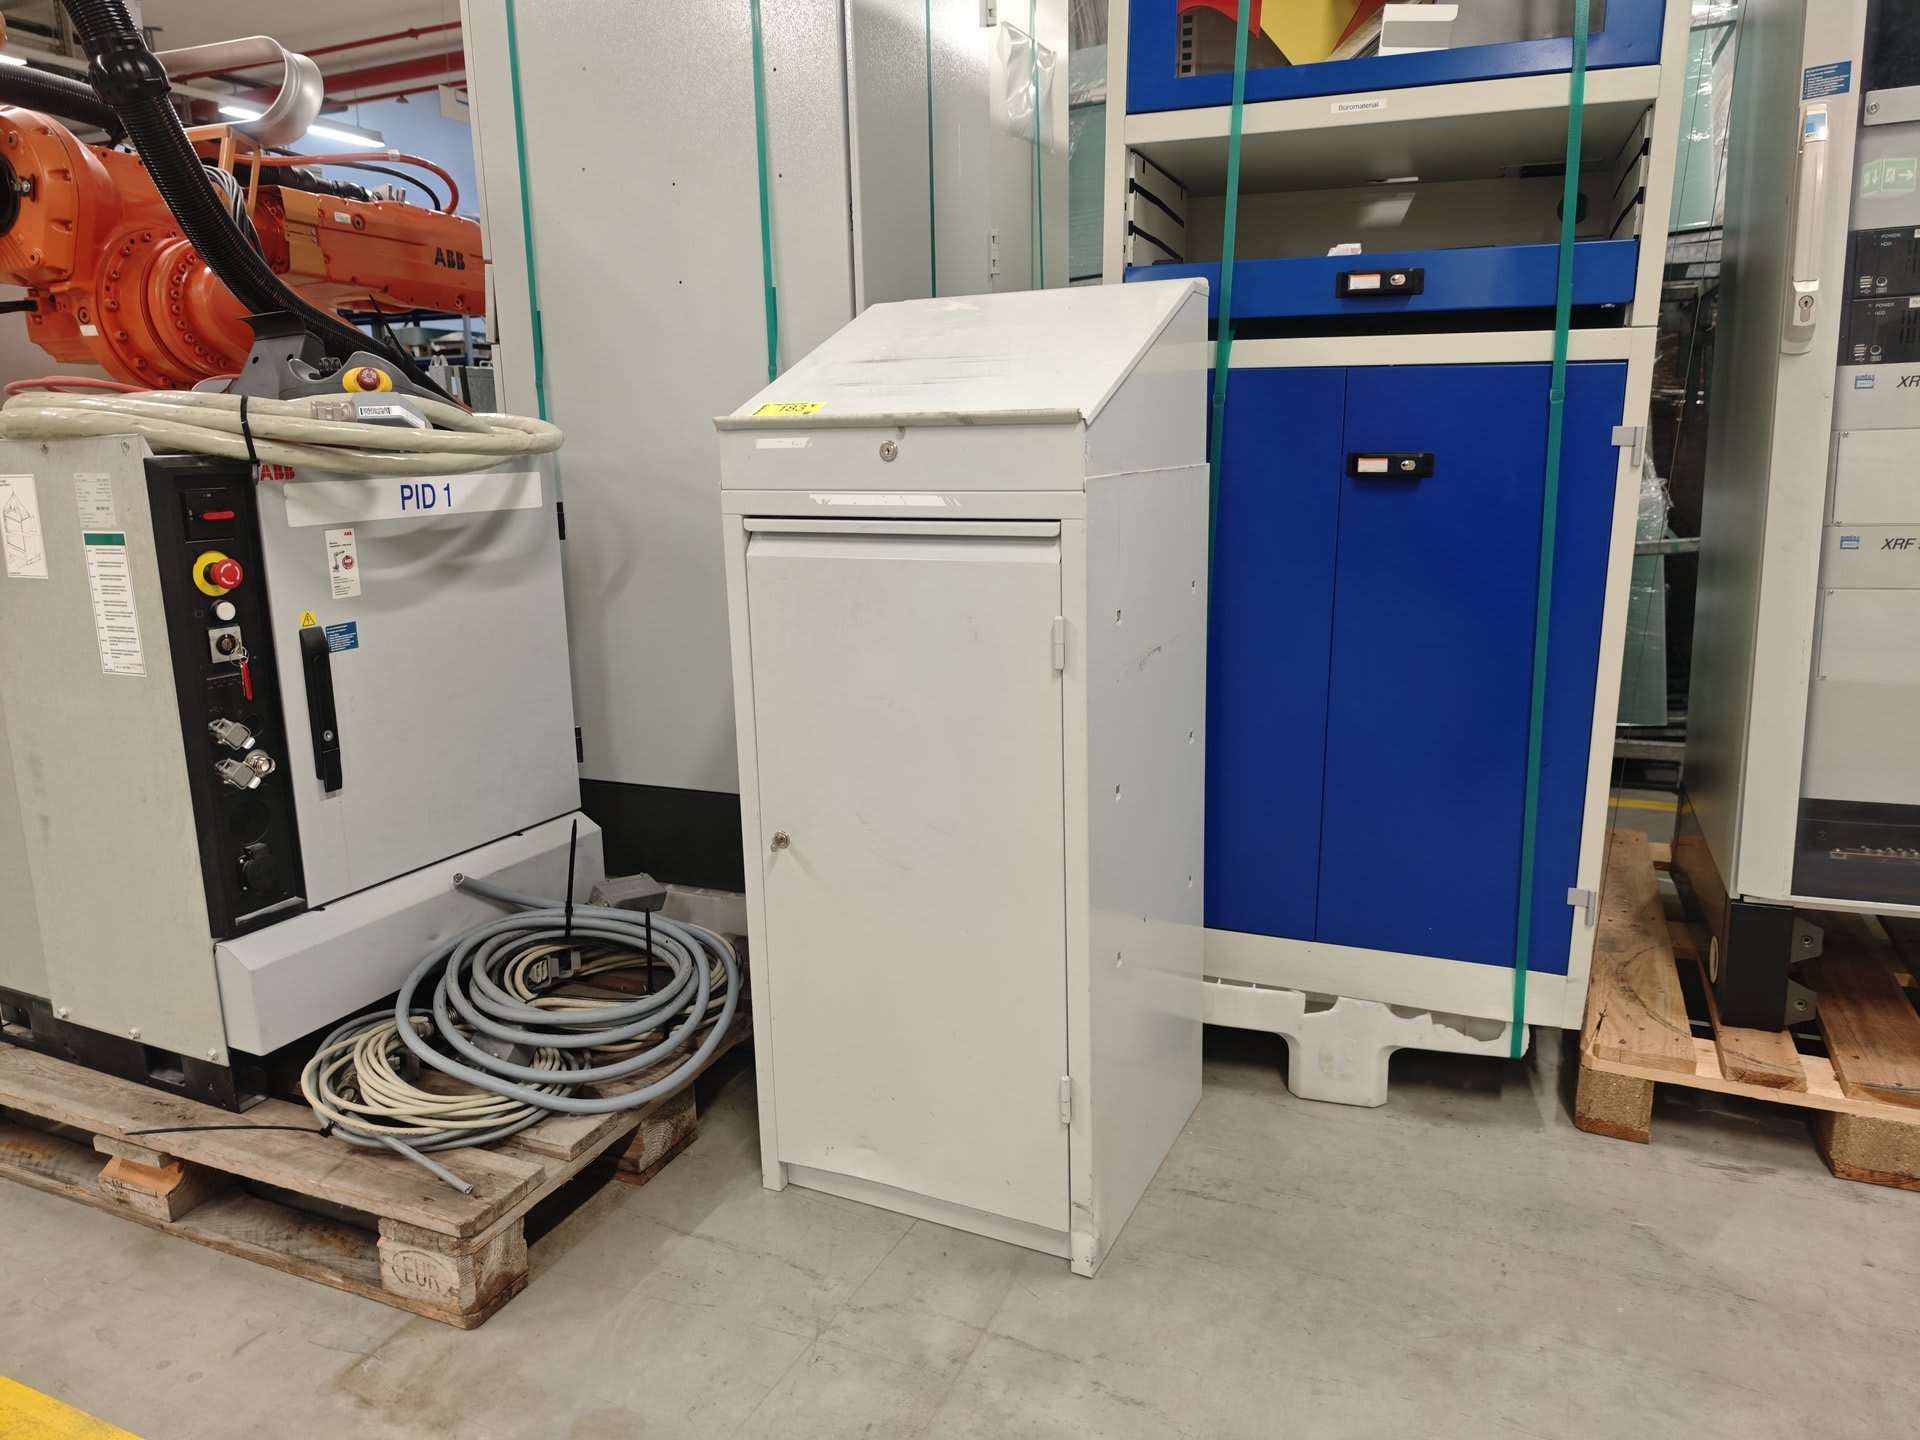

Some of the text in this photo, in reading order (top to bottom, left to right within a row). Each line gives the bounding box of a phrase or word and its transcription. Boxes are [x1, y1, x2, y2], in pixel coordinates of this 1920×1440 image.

[434, 247, 466, 271] ABB
[260, 463, 295, 481] ABB
[400, 482, 452, 510] PID 1
[1880, 537, 1917, 550] XRF
[402, 1256, 440, 1292] EUR
